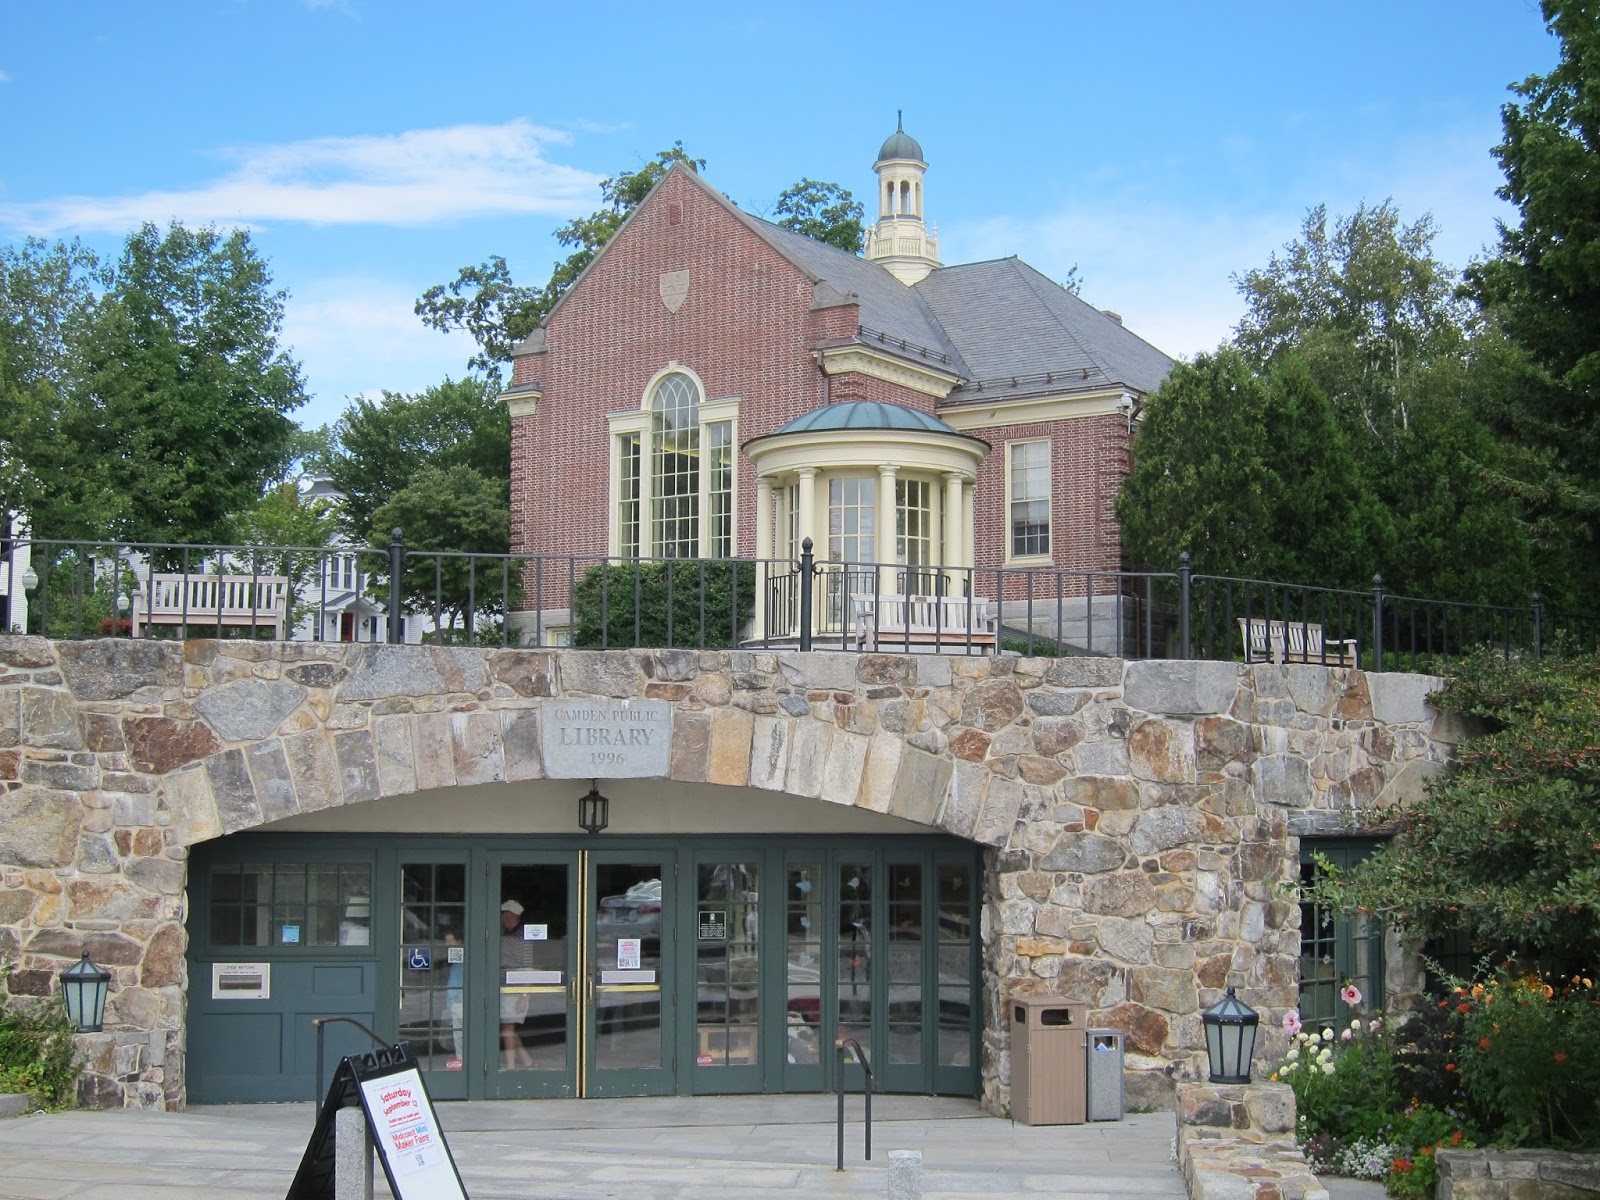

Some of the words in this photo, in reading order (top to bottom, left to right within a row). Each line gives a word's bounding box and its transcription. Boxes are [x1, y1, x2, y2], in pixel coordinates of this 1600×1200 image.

[555, 709, 606, 721] CAMDEN
[612, 710, 659, 722] PUBLIC
[558, 727, 655, 746] LIBRARY
[590, 752, 625, 765] 1996
[380, 1088, 411, 1103] Saturday
[383, 1099, 411, 1117] September
[392, 1129, 417, 1141] Midcoast
[395, 1138, 414, 1151] Maker
[414, 1133, 430, 1144] Faire
